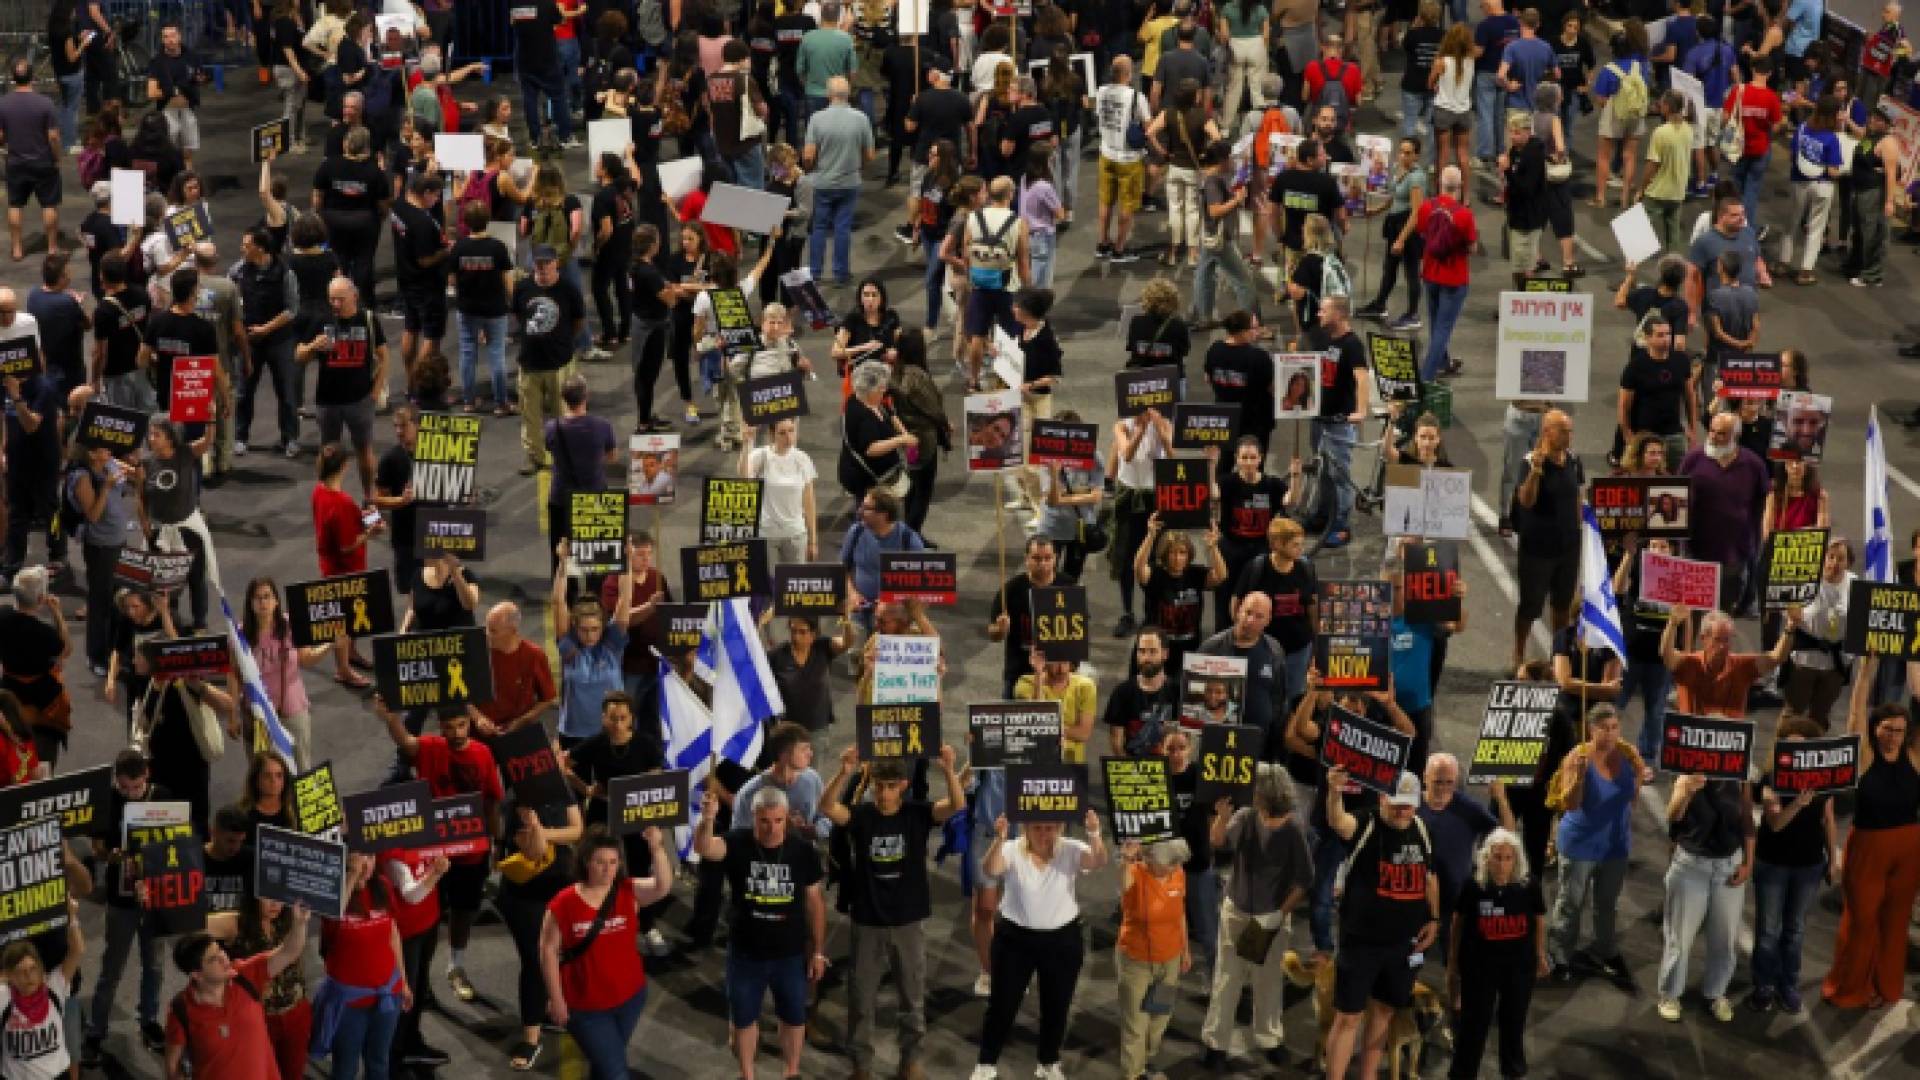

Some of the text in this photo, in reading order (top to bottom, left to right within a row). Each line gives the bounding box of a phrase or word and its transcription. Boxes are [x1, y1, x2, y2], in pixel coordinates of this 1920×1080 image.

[1511, 299, 1584, 322] אין חירות
[752, 383, 793, 403] עסקה
[1127, 378, 1168, 395] עסקה
[1187, 415, 1230, 428] עסקה
[415, 431, 479, 464] HOME
[412, 462, 475, 504] NOW!
[1155, 483, 1209, 511] HELP
[1595, 486, 1640, 507] EDEN
[429, 520, 474, 536] עסקה
[305, 577, 369, 604] HOSTAGE
[787, 577, 833, 594] עסקה
[1406, 569, 1458, 601] HELP
[308, 601, 347, 623] DEAL
[1870, 587, 1920, 612] HOSTA
[311, 620, 347, 642] NOW
[671, 617, 706, 633] סקה
[1038, 614, 1085, 641] S.O.S
[1867, 610, 1906, 632] DEAL
[396, 634, 466, 661] HOSTAGE
[669, 631, 700, 647] שיו!
[1865, 630, 1905, 655] NOW
[398, 659, 440, 681] DEAL
[1328, 654, 1371, 678] NOW
[399, 682, 441, 706] NOW
[1491, 685, 1560, 710] LEAVING
[1482, 708, 1554, 739] NO ONE
[1339, 720, 1400, 766] השבתה
[1680, 725, 1746, 752] השבתה
[1474, 739, 1546, 765] BEHIND!
[1791, 745, 1854, 770] השבתה
[1203, 753, 1254, 785] S.O.S
[625, 785, 676, 807] עסקה
[1023, 778, 1074, 795] עסקה
[22, 788, 90, 819] עסקה
[362, 799, 418, 827] עסקה
[1018, 795, 1078, 811] עכשיו!
[0, 818, 61, 860] EAVING
[0, 847, 65, 894] O ONE
[0, 877, 67, 921] EHIND!
[143, 870, 204, 910] HELP
